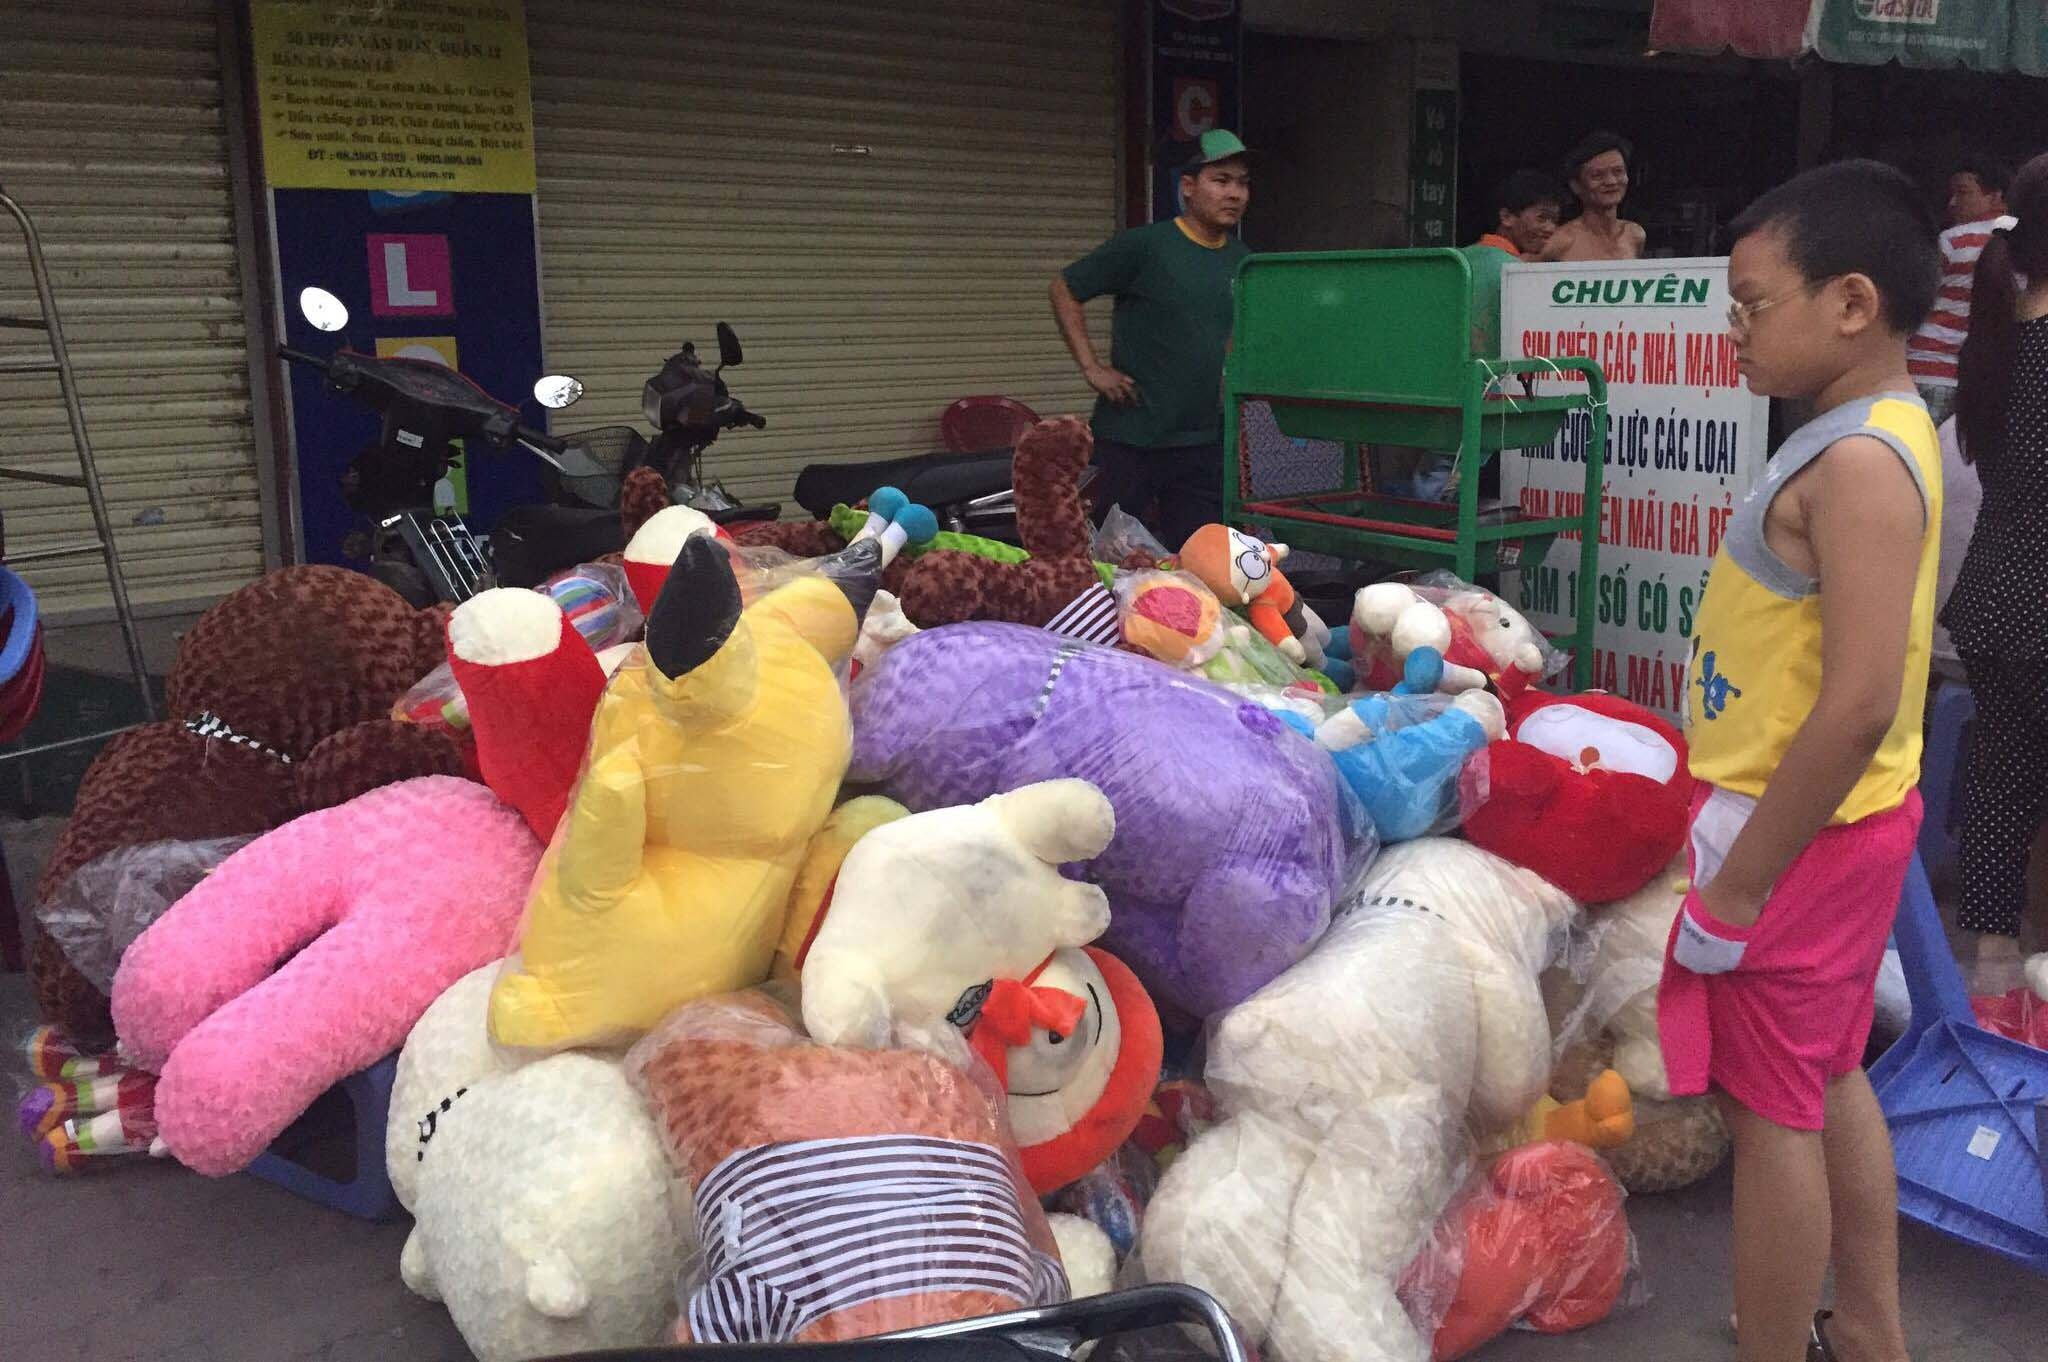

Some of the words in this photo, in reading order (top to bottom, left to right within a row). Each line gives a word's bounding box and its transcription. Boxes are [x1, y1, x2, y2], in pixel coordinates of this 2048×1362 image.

[1551, 274, 1711, 304] CHUYÊN
[1522, 330, 1550, 381] SIM
[1603, 321, 1637, 384] CÁC
[1685, 333, 1740, 398] MẠNG
[1618, 409, 1649, 477] LỰC
[1655, 407, 1690, 471] CÁC
[1695, 419, 1738, 485] LOẠI
[1628, 489, 1663, 551] MÃI
[1670, 493, 1700, 556] GIÁ
[1520, 566, 1559, 615] SIM
[1599, 563, 1630, 627] SỐ
[1638, 572, 1668, 634] CÓ
[1626, 650, 1685, 712] MÁY
